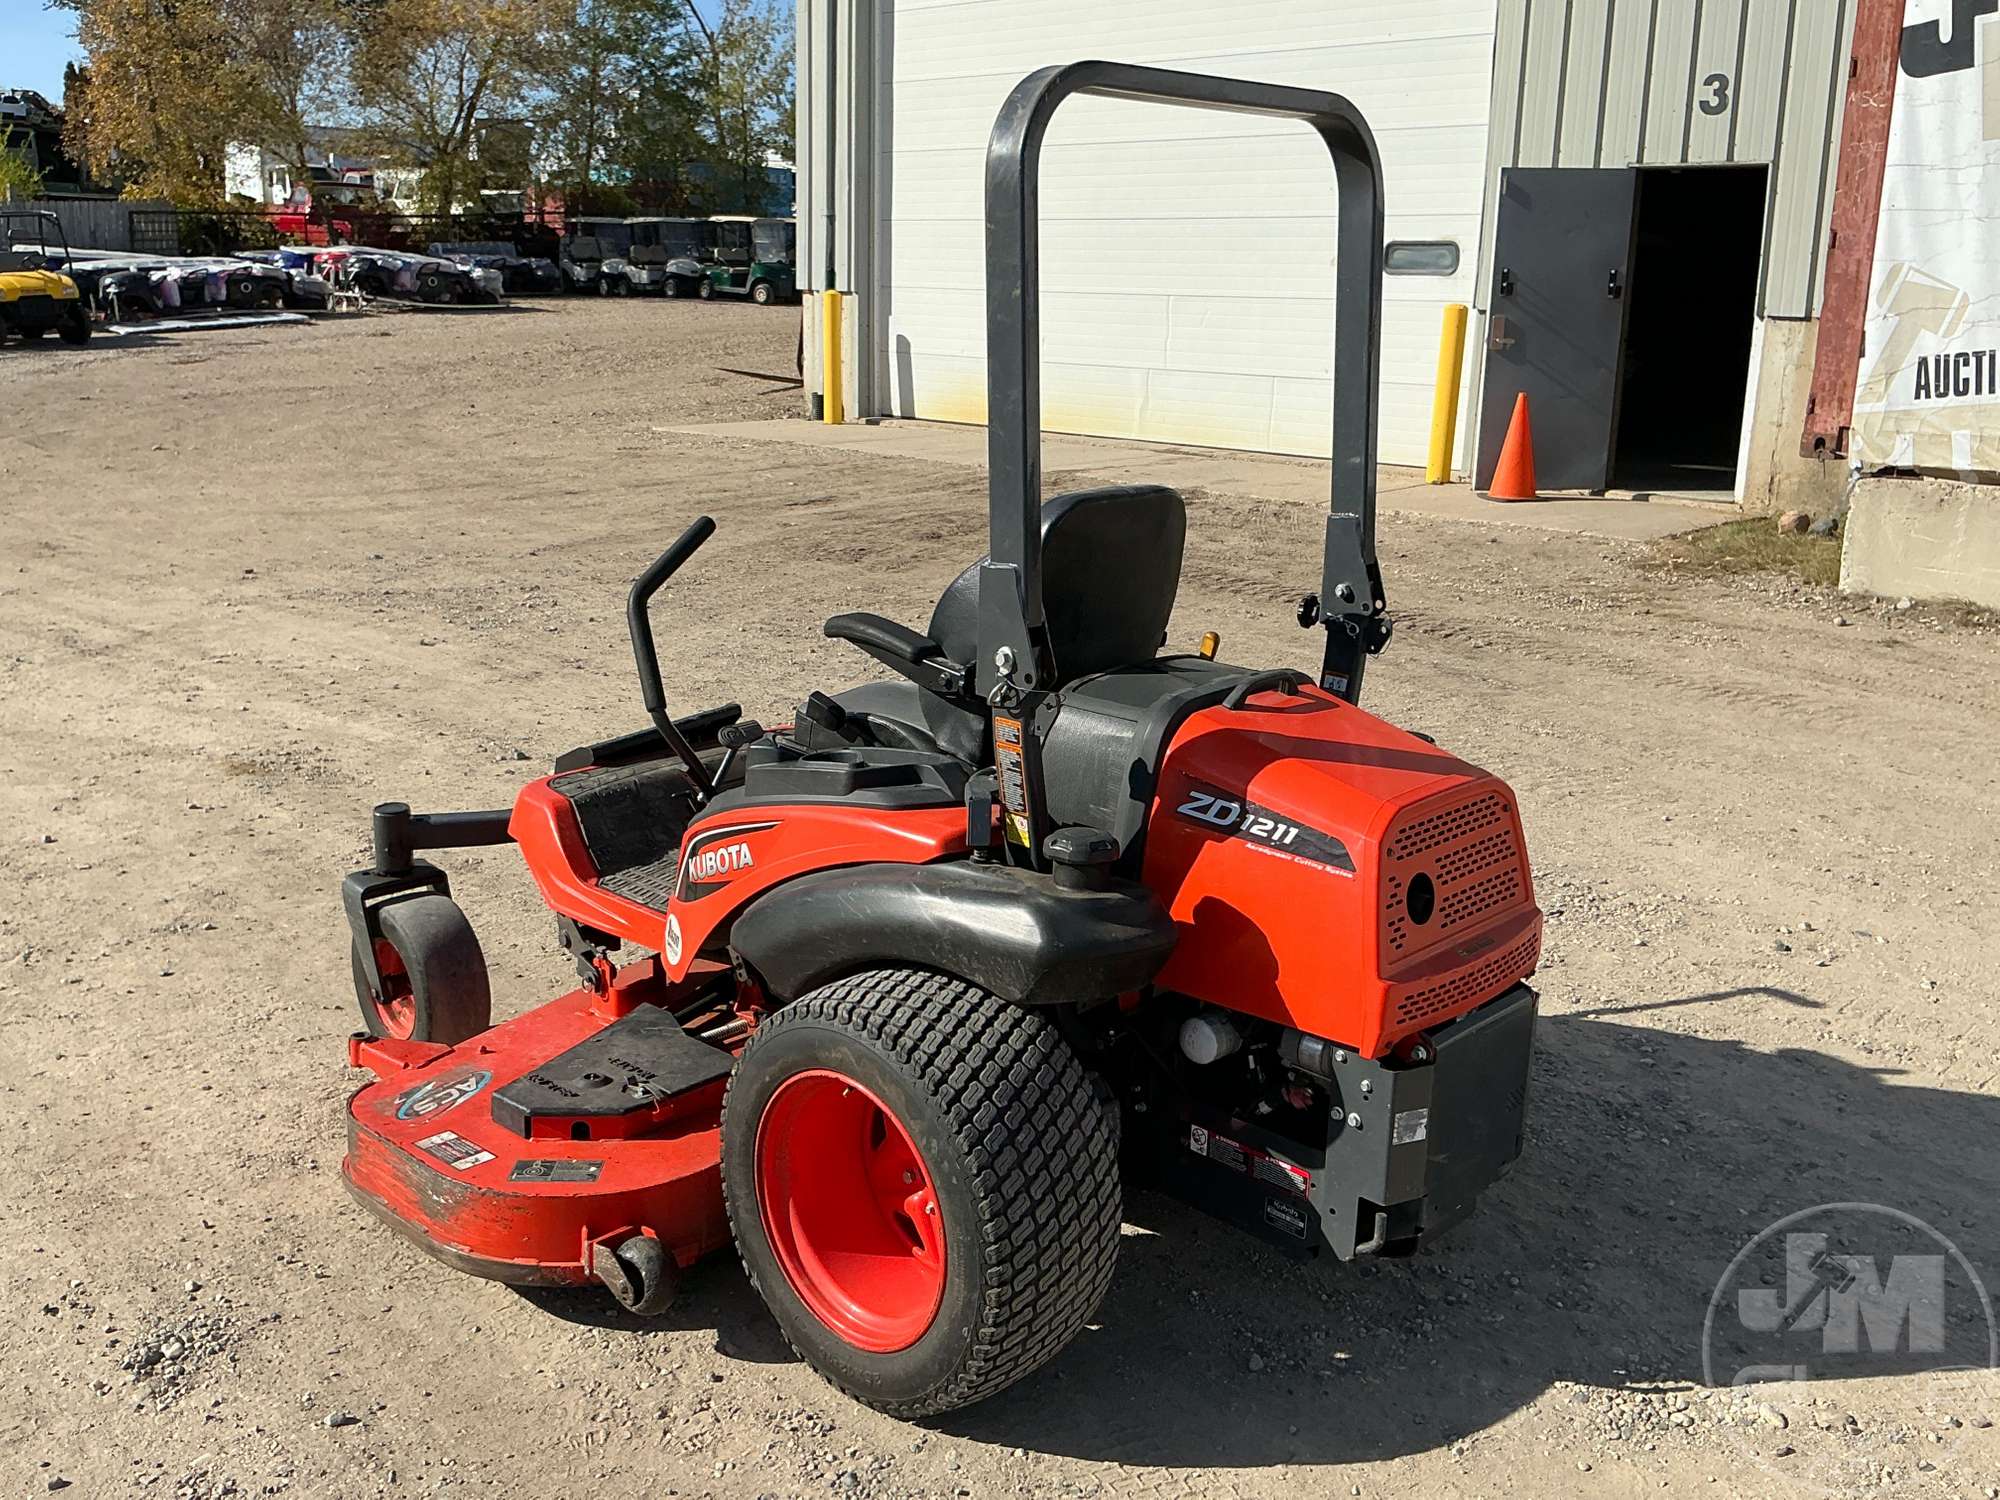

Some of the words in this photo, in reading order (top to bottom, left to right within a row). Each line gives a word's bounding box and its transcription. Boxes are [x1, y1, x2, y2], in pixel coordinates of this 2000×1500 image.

[1699, 73, 1730, 116] 3
[1914, 348, 1997, 400] AUCTI
[688, 843, 754, 882] KUBOTA
[1293, 856, 1324, 871] Cutting
[412, 1076, 478, 1116] ACS
